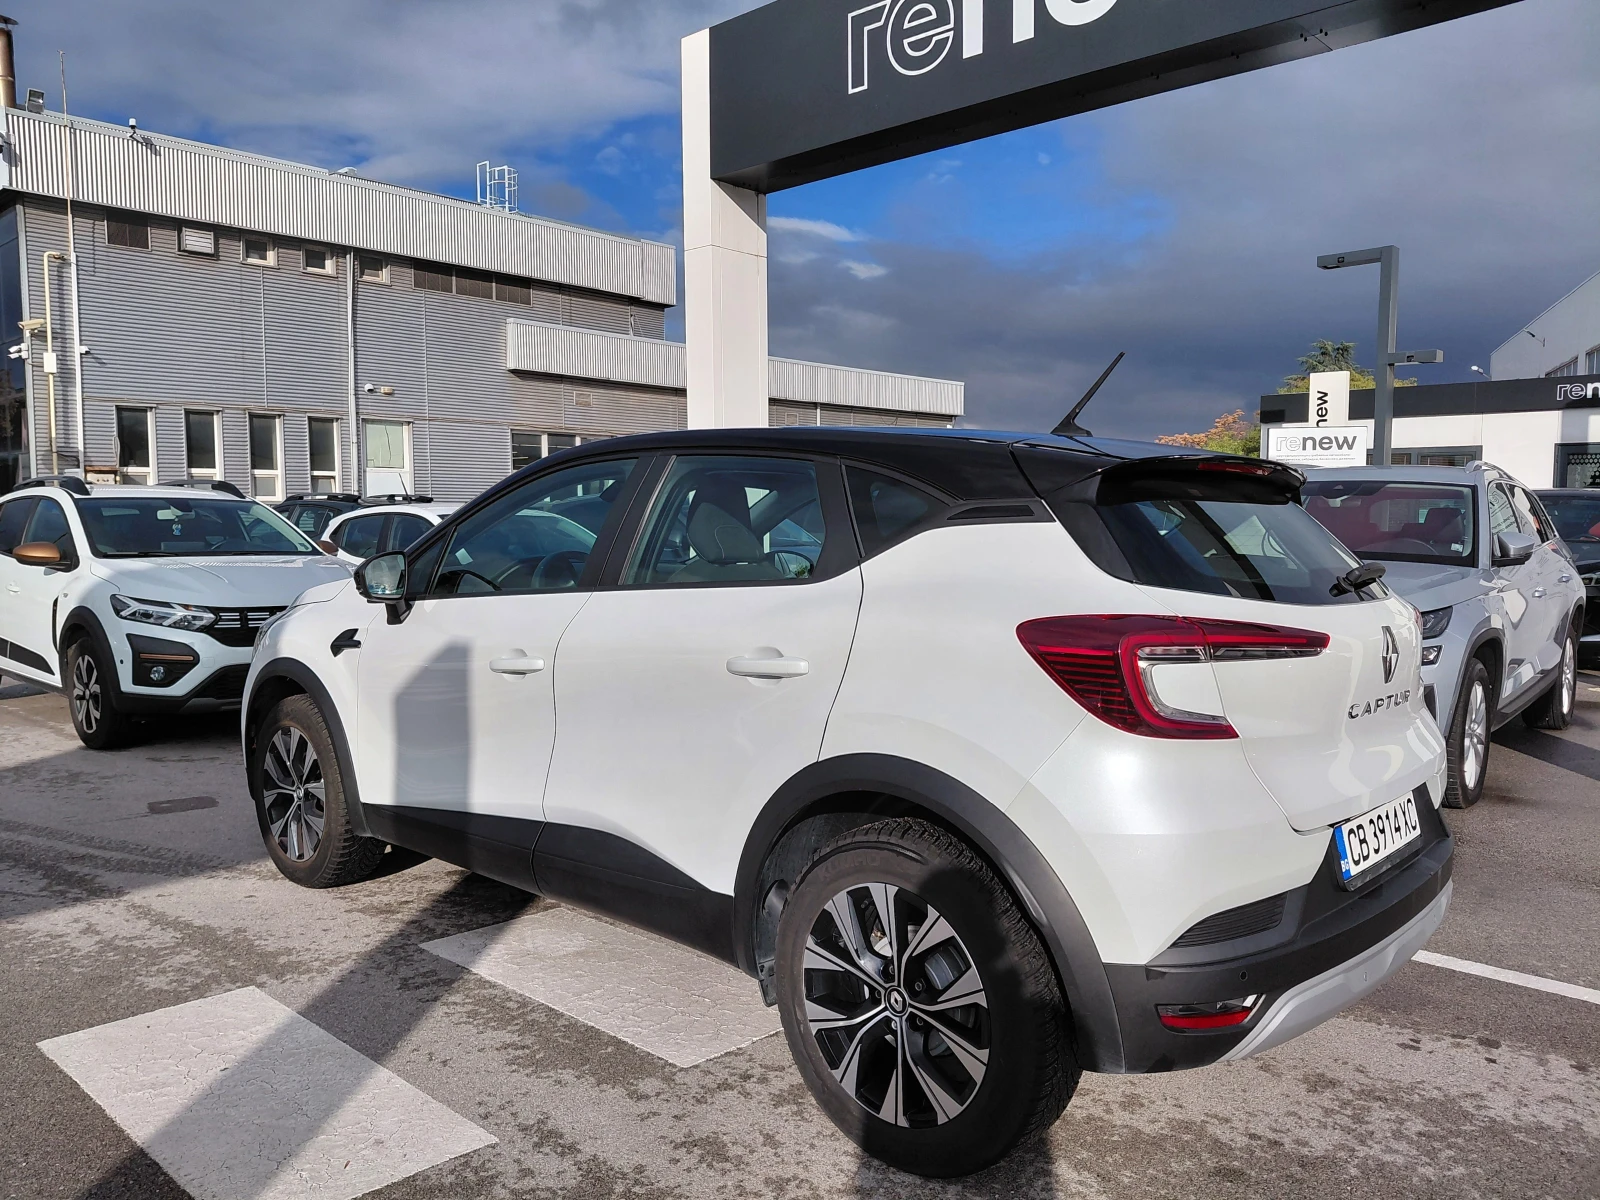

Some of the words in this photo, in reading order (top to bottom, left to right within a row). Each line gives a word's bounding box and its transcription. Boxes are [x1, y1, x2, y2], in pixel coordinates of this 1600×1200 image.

[848, 0, 1118, 94] ren
[1276, 435, 1357, 451] renew
[1348, 690, 1411, 719] CAPTUR
